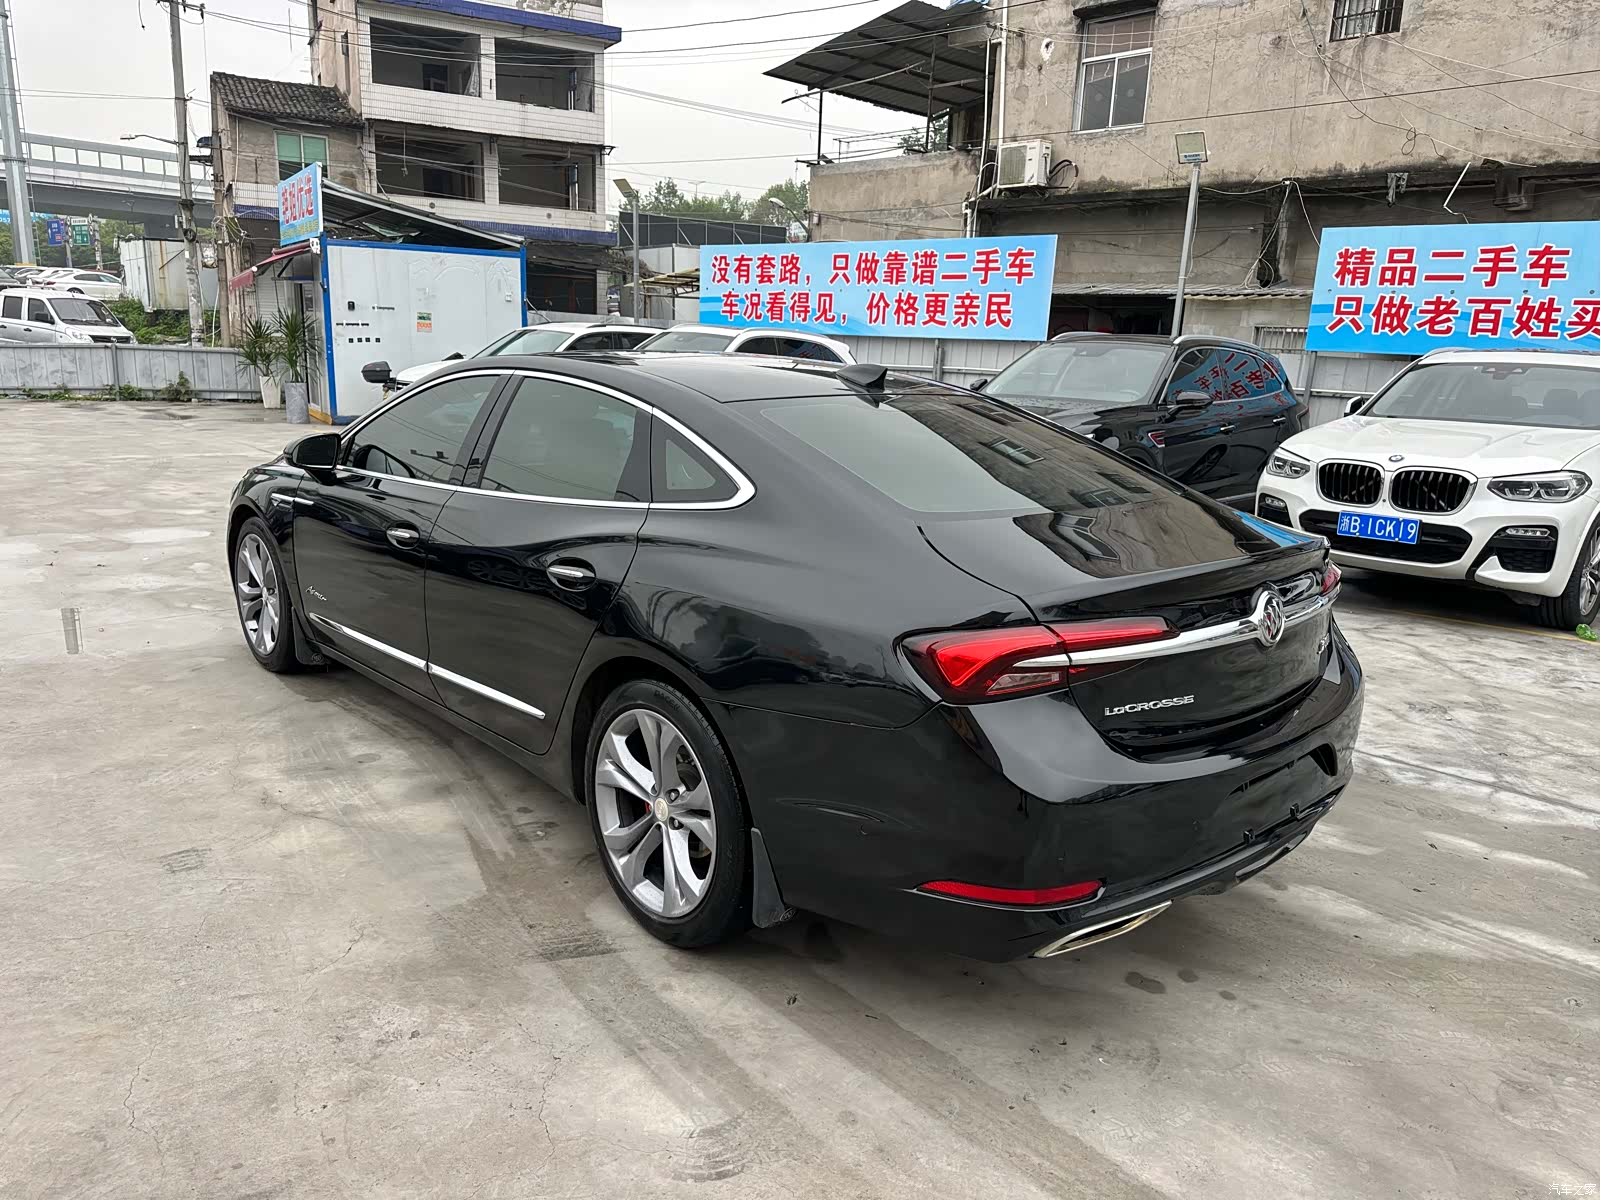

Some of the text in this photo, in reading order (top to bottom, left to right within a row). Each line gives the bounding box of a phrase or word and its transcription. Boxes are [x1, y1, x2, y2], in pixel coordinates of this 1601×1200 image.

[710, 247, 1036, 286] 没有套路，只做靠谱二手车
[1334, 244, 1571, 288] 精品二手车
[720, 290, 1013, 328] 车况看得见，价格更亲民
[1326, 294, 1600, 339] 只做老百姓买
